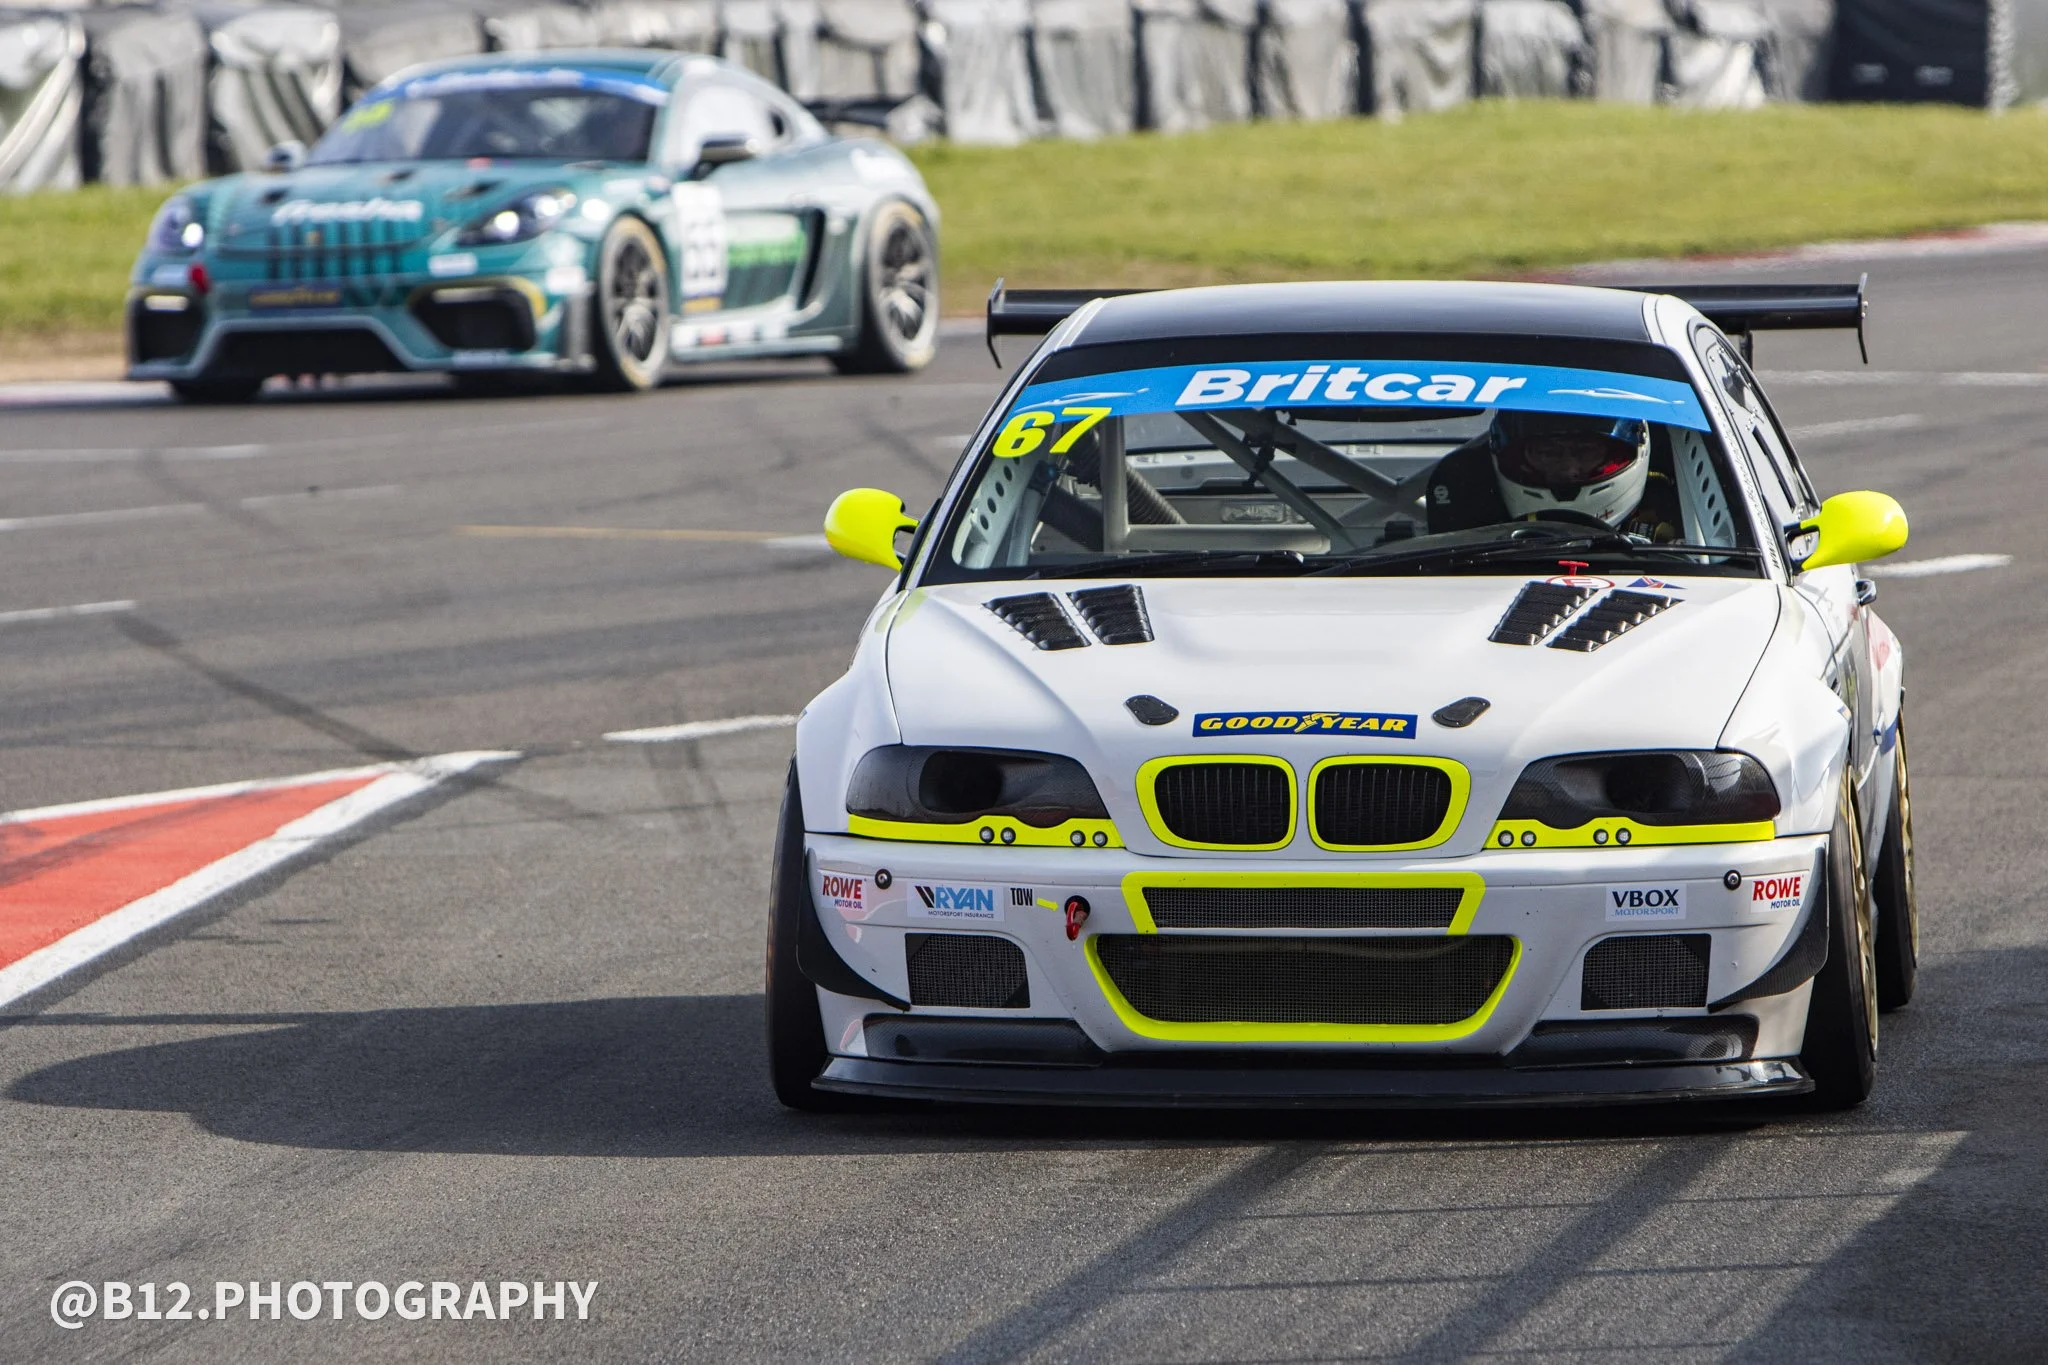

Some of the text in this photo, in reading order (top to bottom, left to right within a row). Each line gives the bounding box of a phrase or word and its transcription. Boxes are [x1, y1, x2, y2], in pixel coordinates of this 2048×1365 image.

[1175, 365, 1527, 406] Britcar
[992, 407, 1112, 458] 67
[1200, 713, 1408, 733] GOODYEAR
[823, 876, 862, 899] ROWE
[1010, 888, 1033, 906] TOW
[1753, 877, 1800, 900] ROWE
[834, 899, 863, 909] MOTOR OIL
[935, 887, 994, 911] RYAN
[1612, 889, 1679, 907] VBOX
[1770, 898, 1801, 909] MOTOR OIL
[1615, 907, 1680, 916] MOTORSPORT
